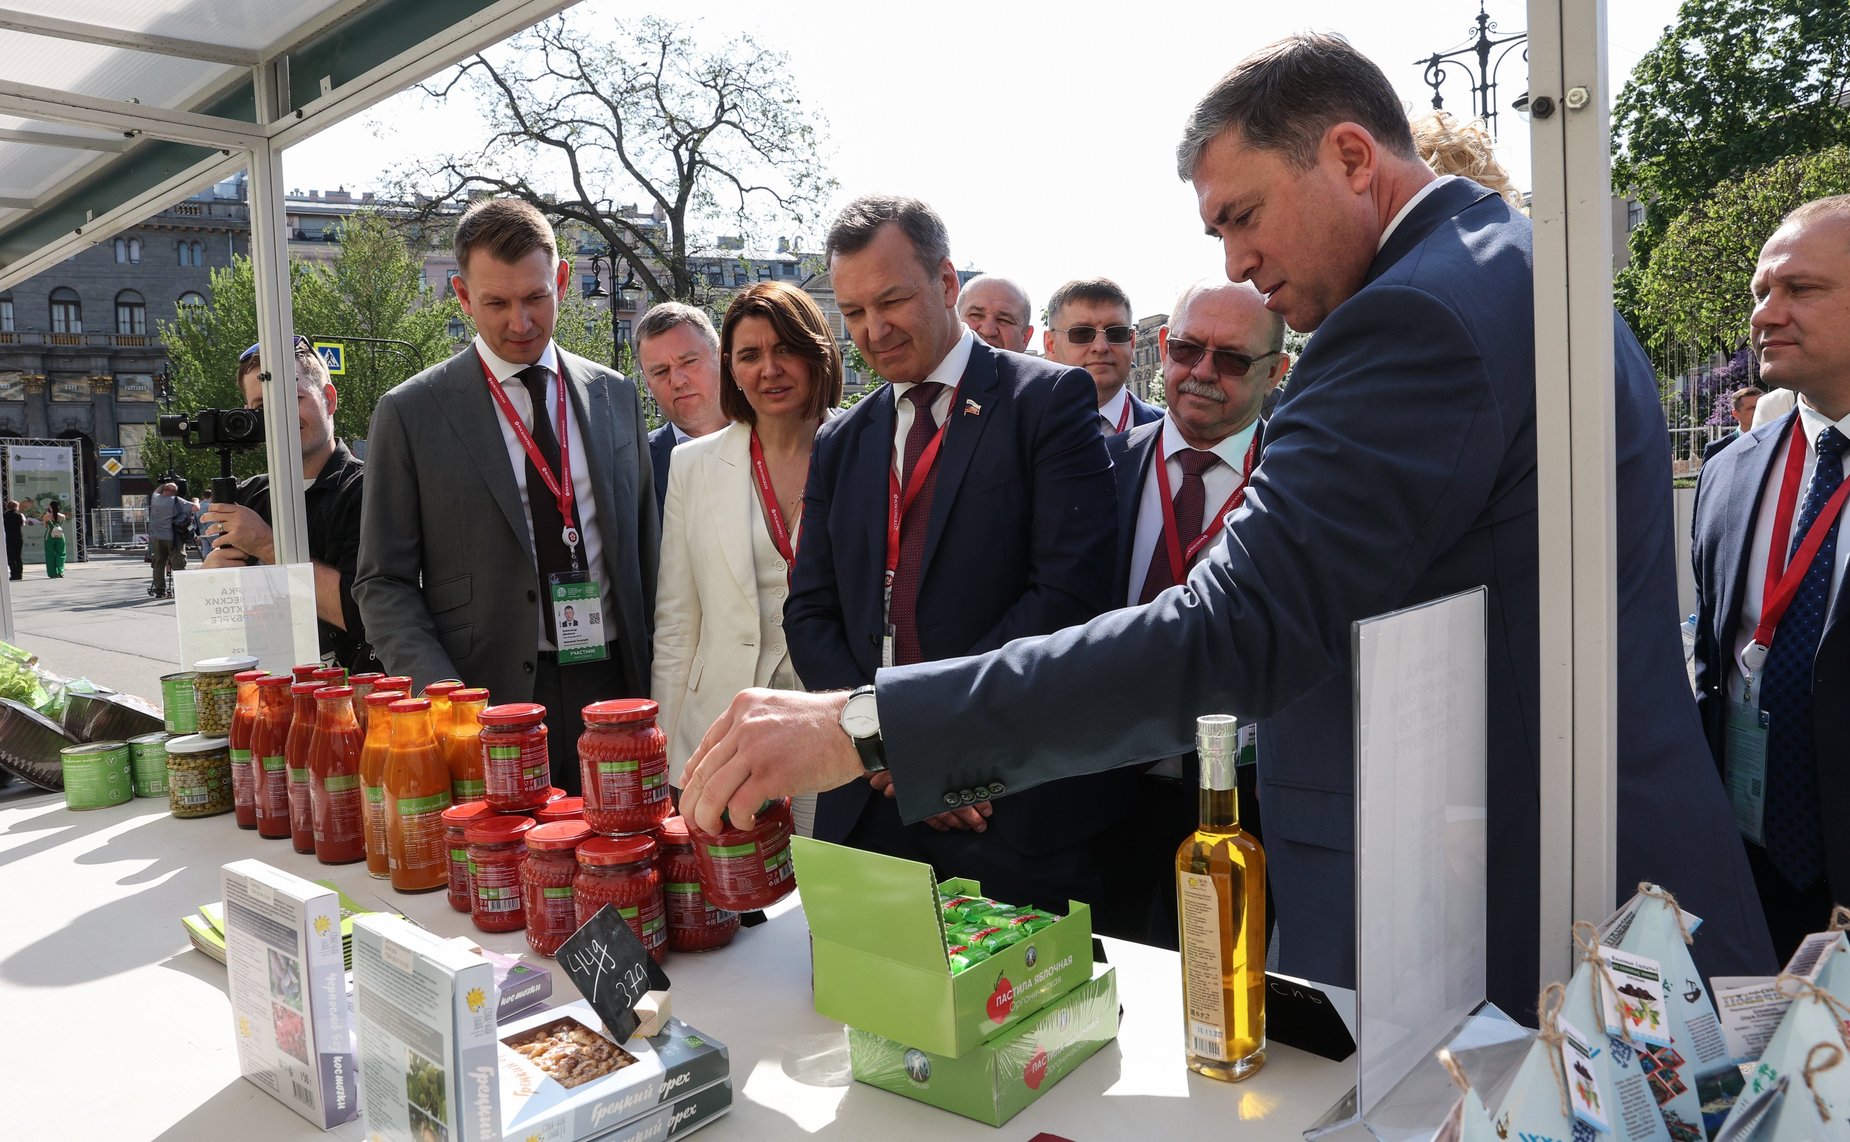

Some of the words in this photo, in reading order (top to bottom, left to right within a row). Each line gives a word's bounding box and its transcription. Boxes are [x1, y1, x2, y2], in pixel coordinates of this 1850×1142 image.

[569, 648, 596, 656] УЧАСТНИК
[500, 983, 542, 1007] косточки
[615, 962, 651, 1008] 379
[996, 979, 1032, 1007] ПАСТИЛА
[1034, 954, 1074, 986] ЯБЛОЧНАЯ
[333, 1056, 346, 1110] косточки
[591, 1084, 655, 1128] Грецкий
[659, 1071, 691, 1100] орех
[667, 1103, 697, 1133] орех
